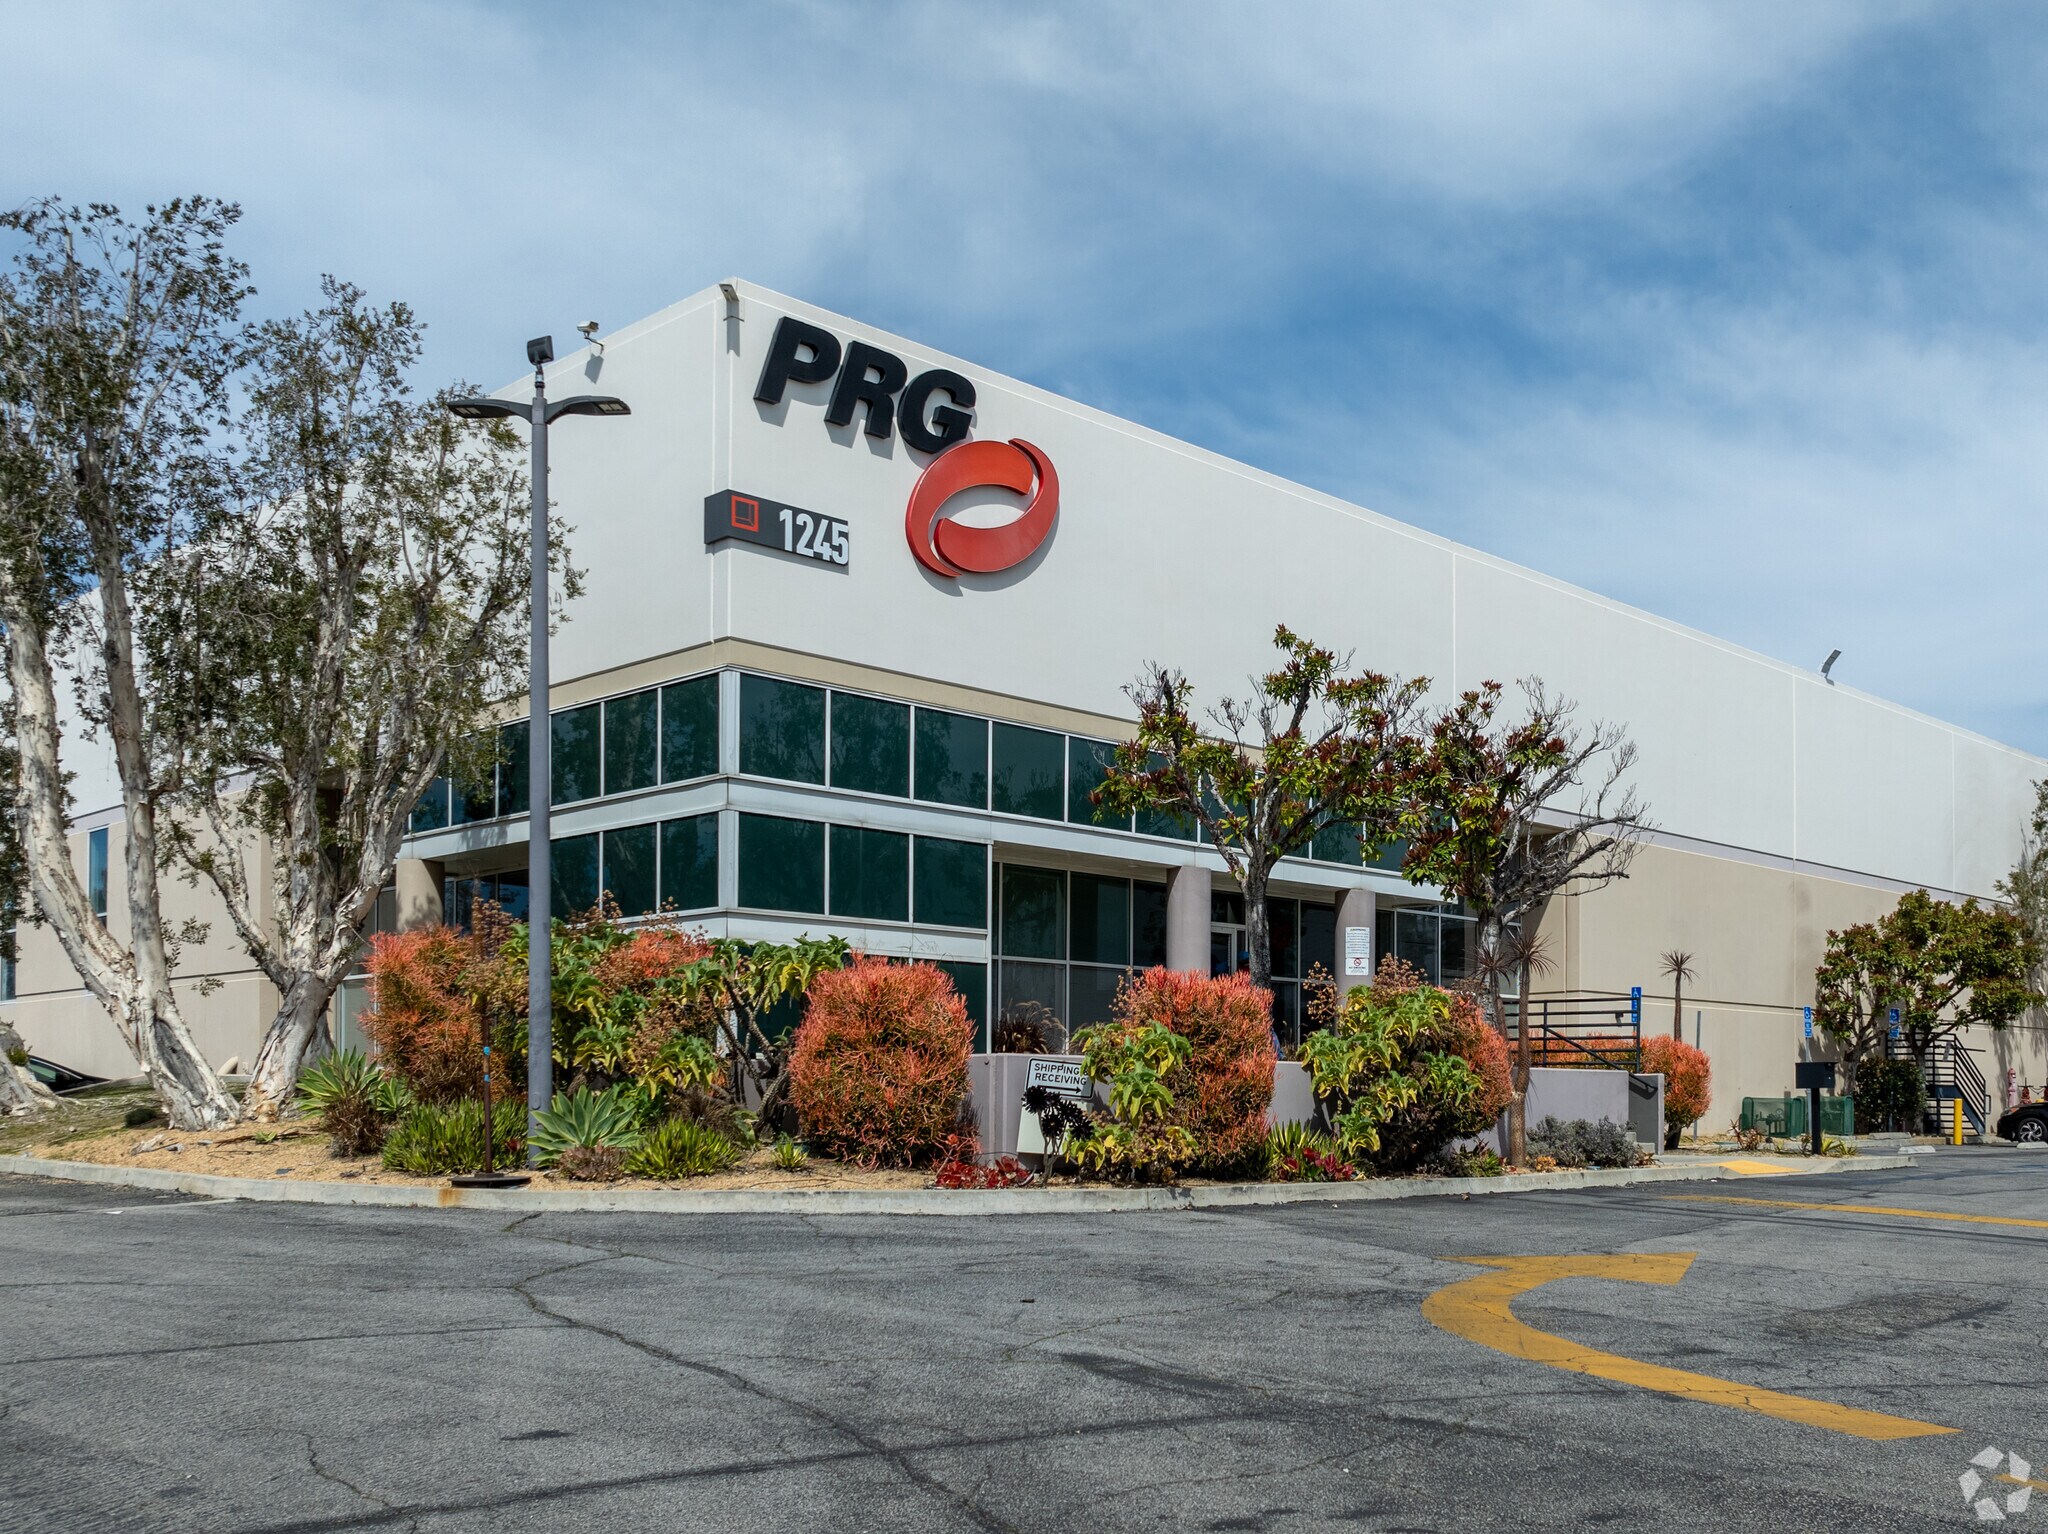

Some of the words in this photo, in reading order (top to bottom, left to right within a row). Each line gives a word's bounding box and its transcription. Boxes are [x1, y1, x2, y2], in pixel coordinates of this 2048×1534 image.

[754, 316, 977, 454] PRG
[779, 508, 849, 565] 1245
[1034, 1063, 1080, 1076] SHIPPING
[1035, 1072, 1087, 1086] RECEIVING
